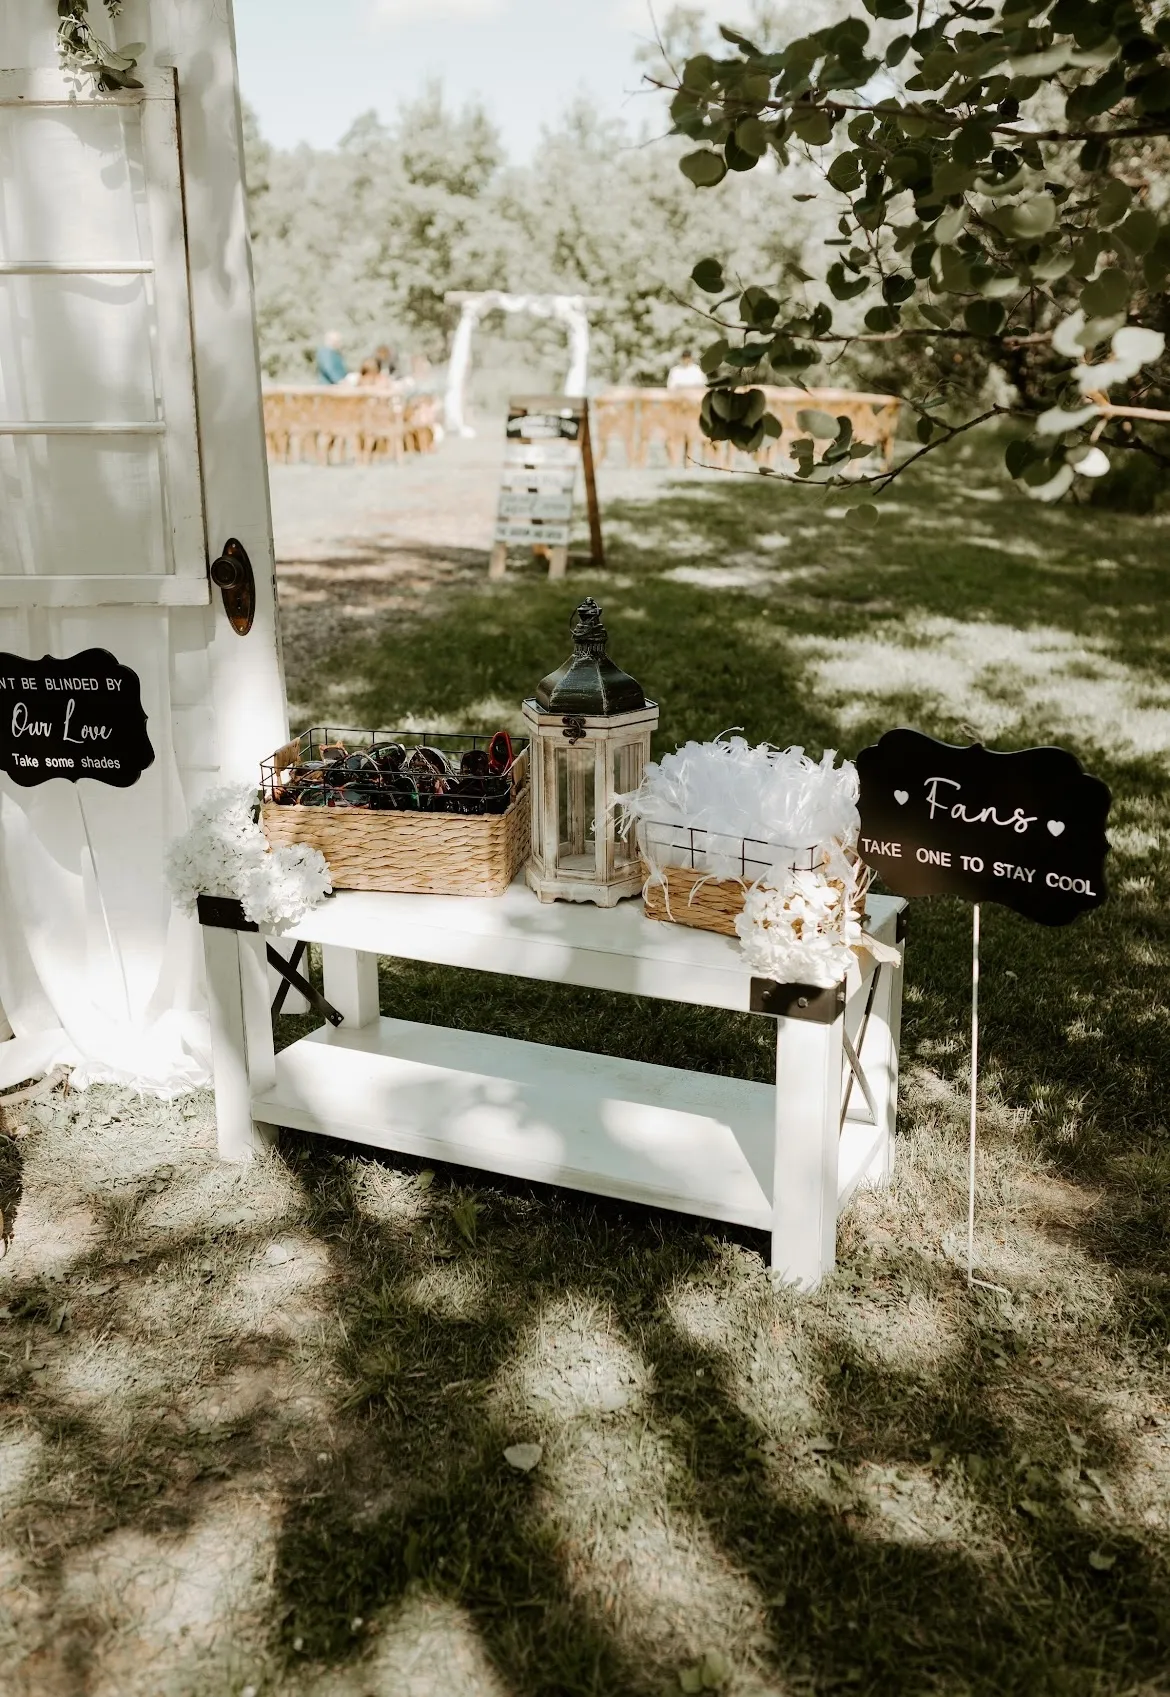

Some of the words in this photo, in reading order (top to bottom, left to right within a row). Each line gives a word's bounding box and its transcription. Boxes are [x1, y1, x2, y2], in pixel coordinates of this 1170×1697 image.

[20, 677, 38, 690] BE
[44, 677, 99, 691] BLINDED
[106, 678, 123, 691] BY
[11, 701, 53, 737] Our
[62, 698, 113, 744] Love
[12, 752, 40, 768] Take
[45, 757, 75, 768] some
[80, 755, 121, 769] shades
[923, 776, 1038, 834] Fans
[861, 838, 902, 858] TAKE
[915, 847, 952, 868] ONE
[960, 855, 985, 873] TO
[992, 861, 1037, 884] STAY
[1045, 872, 1097, 897] COOL
